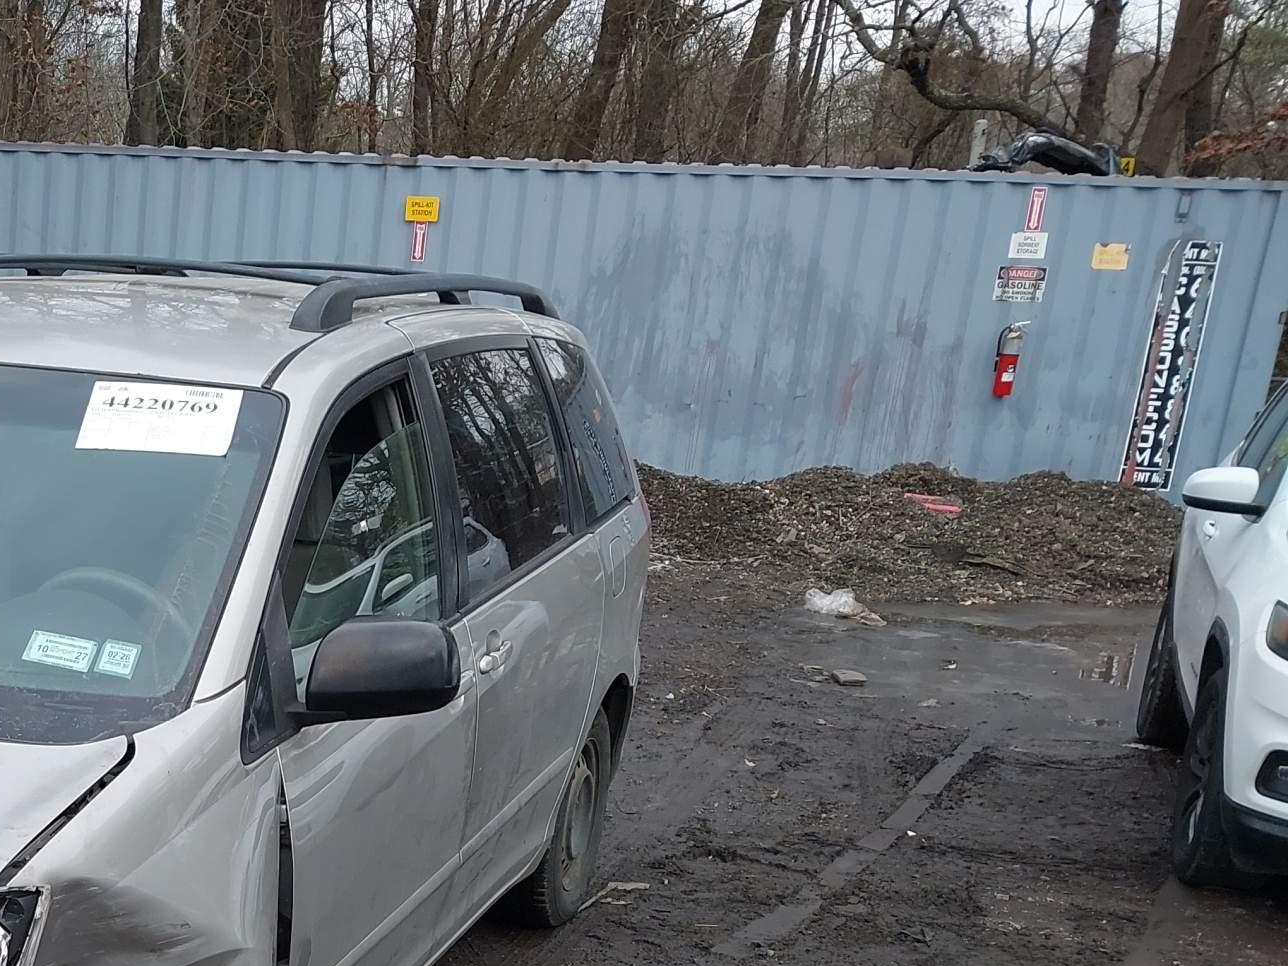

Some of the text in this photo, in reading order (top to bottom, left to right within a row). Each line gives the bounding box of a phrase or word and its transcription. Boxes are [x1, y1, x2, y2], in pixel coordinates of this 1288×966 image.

[997, 281, 1043, 291] GASOLINE
[102, 395, 219, 414] 44220769
[74, 651, 88, 661] 27
